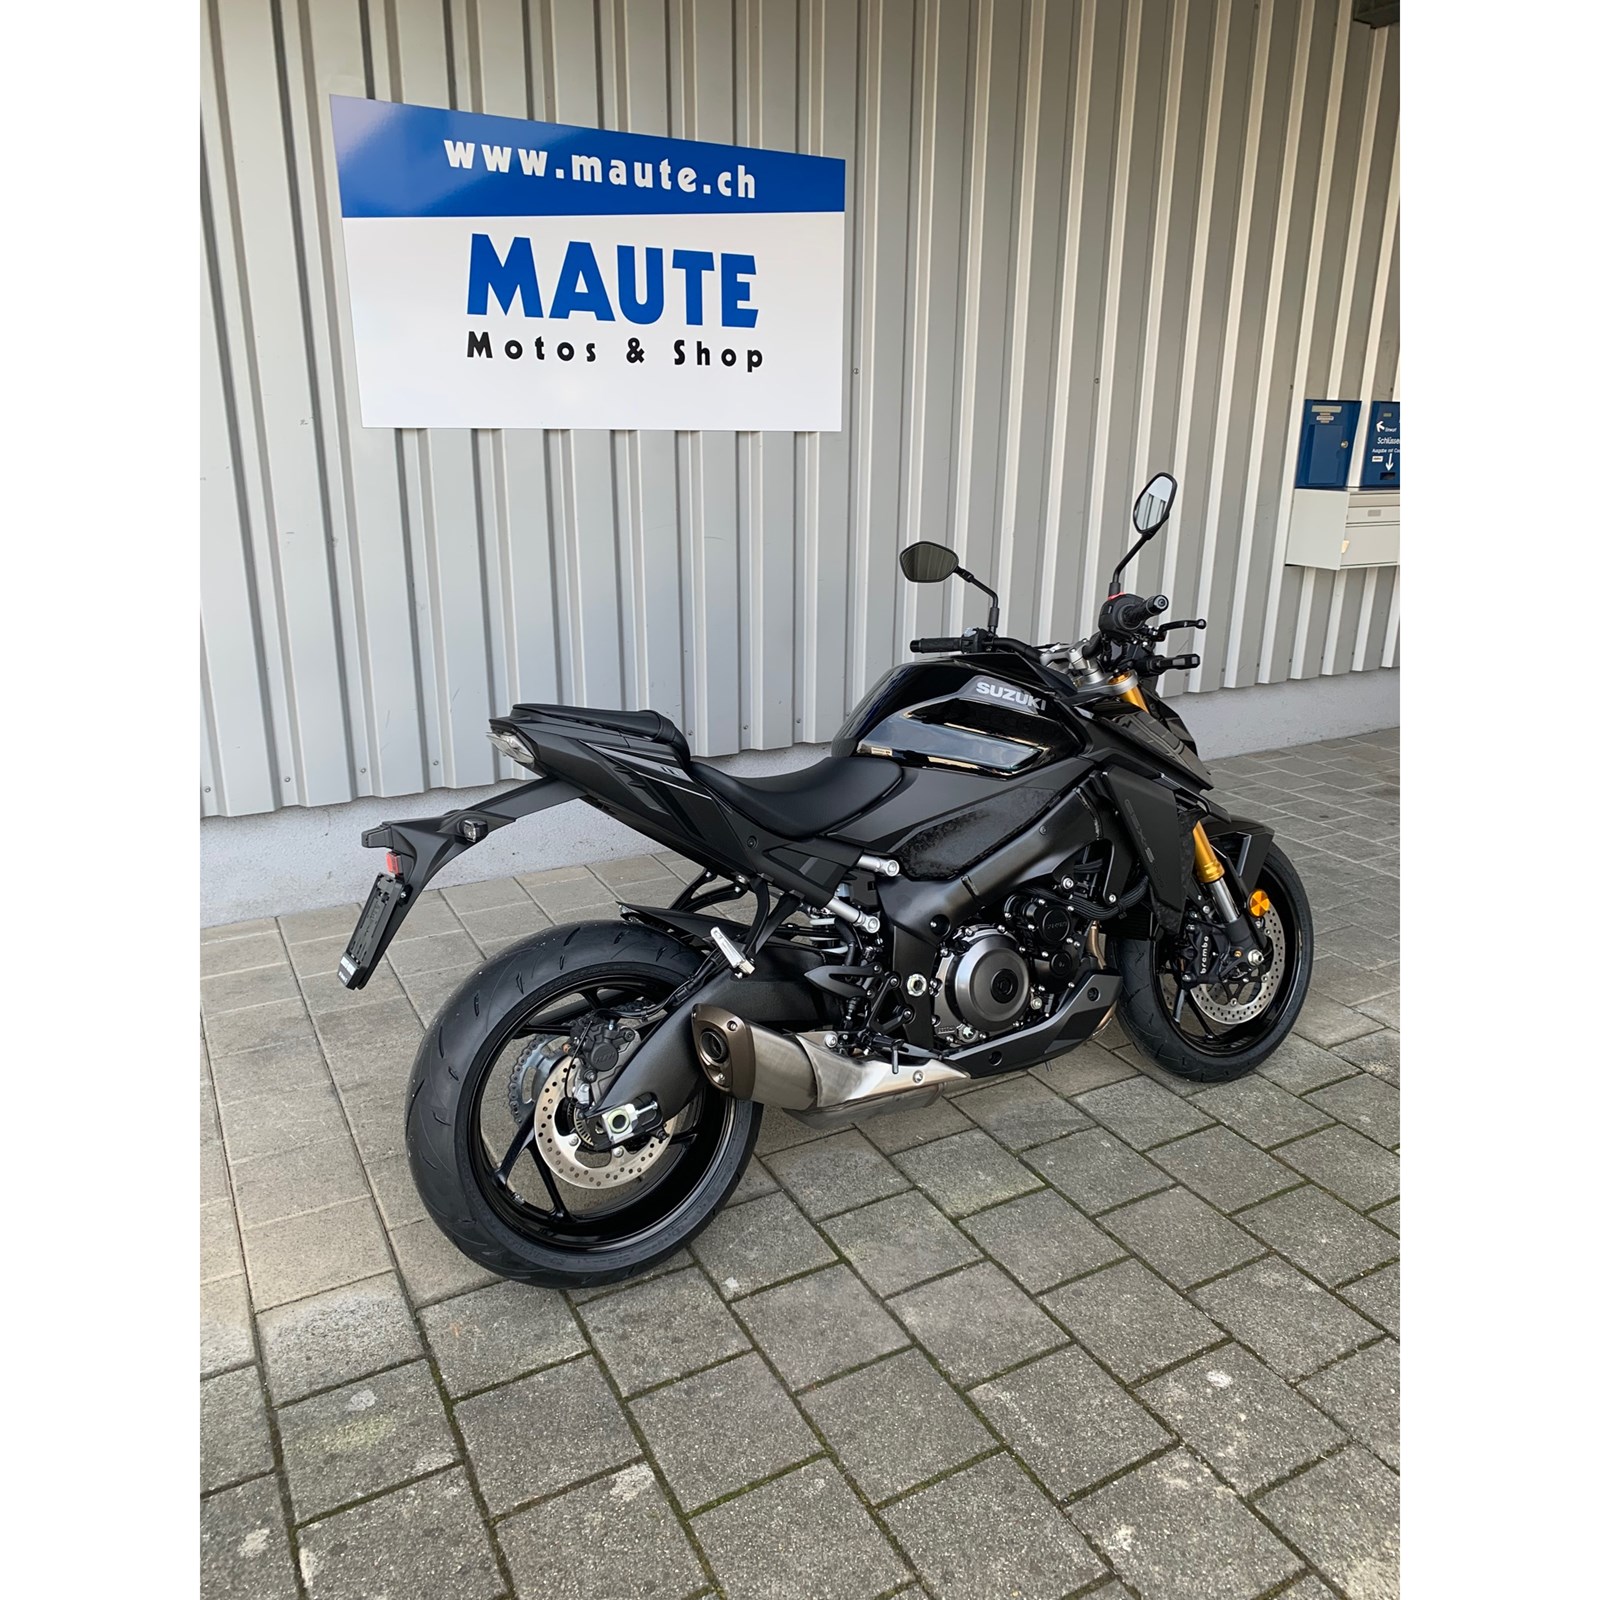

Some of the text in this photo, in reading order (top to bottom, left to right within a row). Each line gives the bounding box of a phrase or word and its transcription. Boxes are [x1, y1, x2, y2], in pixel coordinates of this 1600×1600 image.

[443, 139, 756, 199] www.maute.ch
[466, 233, 760, 329] MAUTE
[466, 331, 764, 373] Motos & Shop
[975, 681, 1047, 711] SUZUKI
[1200, 935, 1209, 974] brembo
